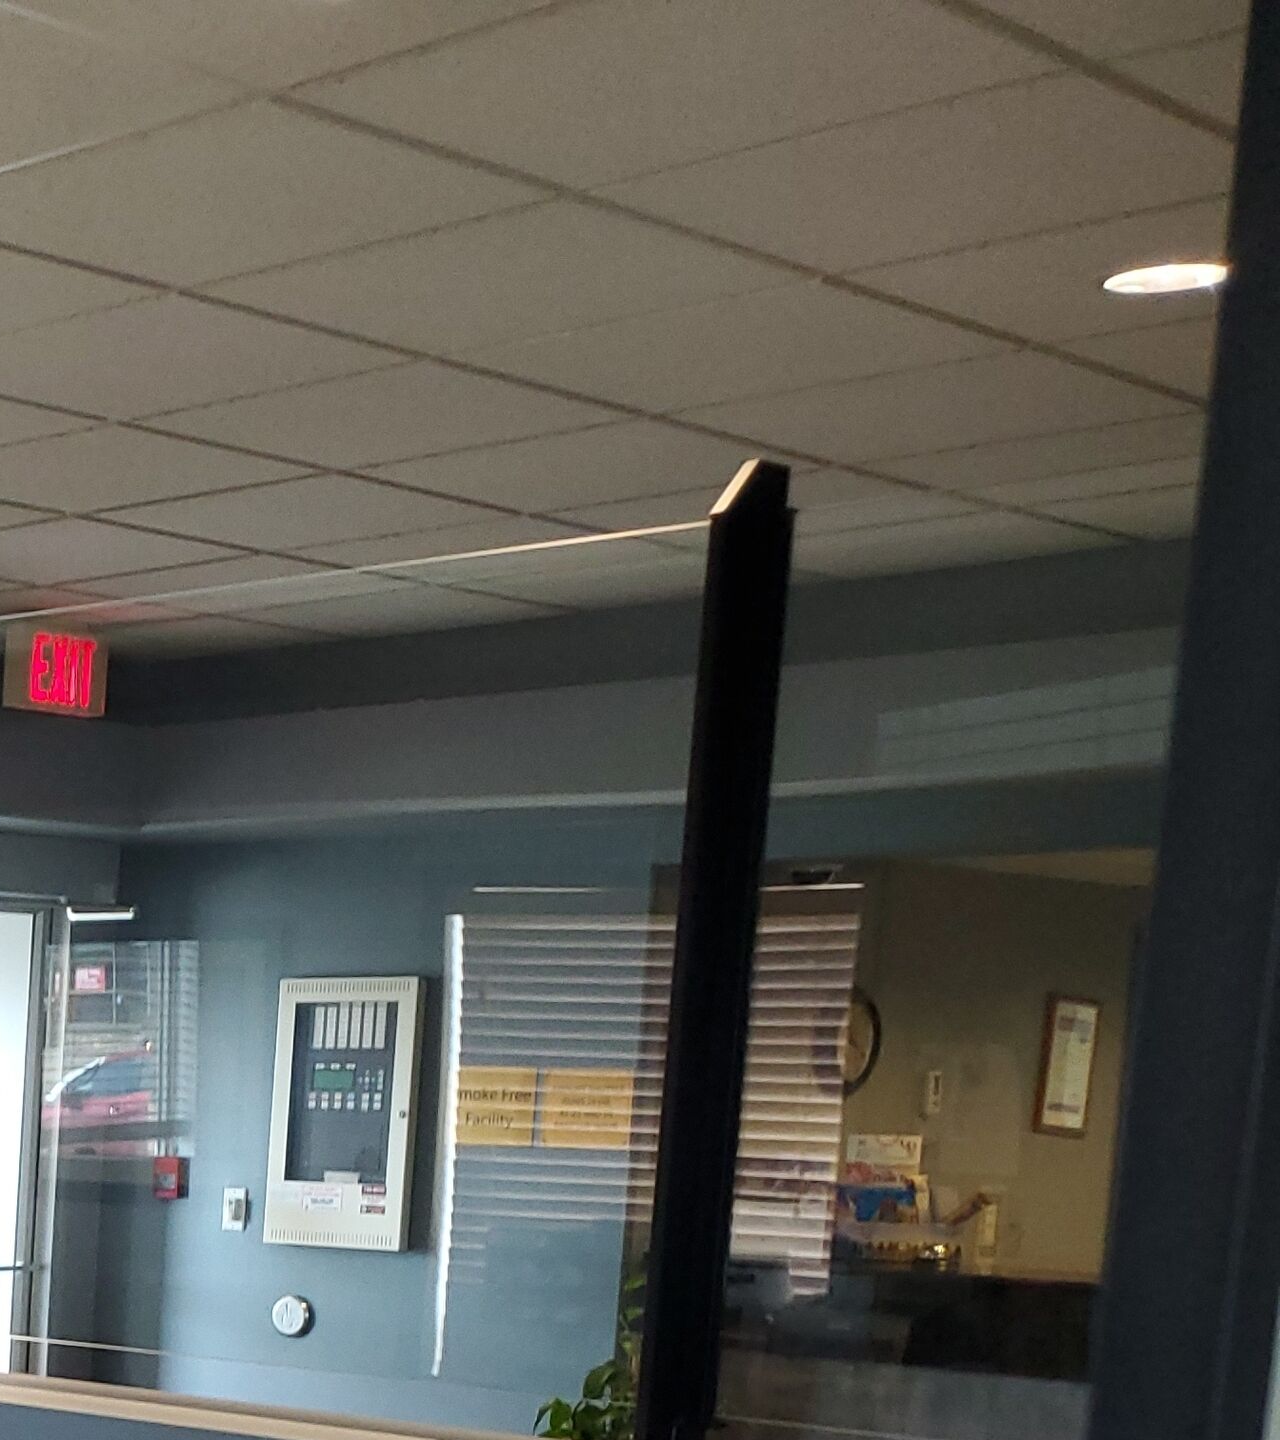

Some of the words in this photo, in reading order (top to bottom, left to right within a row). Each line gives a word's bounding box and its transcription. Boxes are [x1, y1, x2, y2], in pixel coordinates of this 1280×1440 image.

[29, 632, 97, 708] EXIT
[459, 1088, 498, 1102] moke
[502, 1088, 532, 1102] Free
[465, 1111, 513, 1129] Facility
